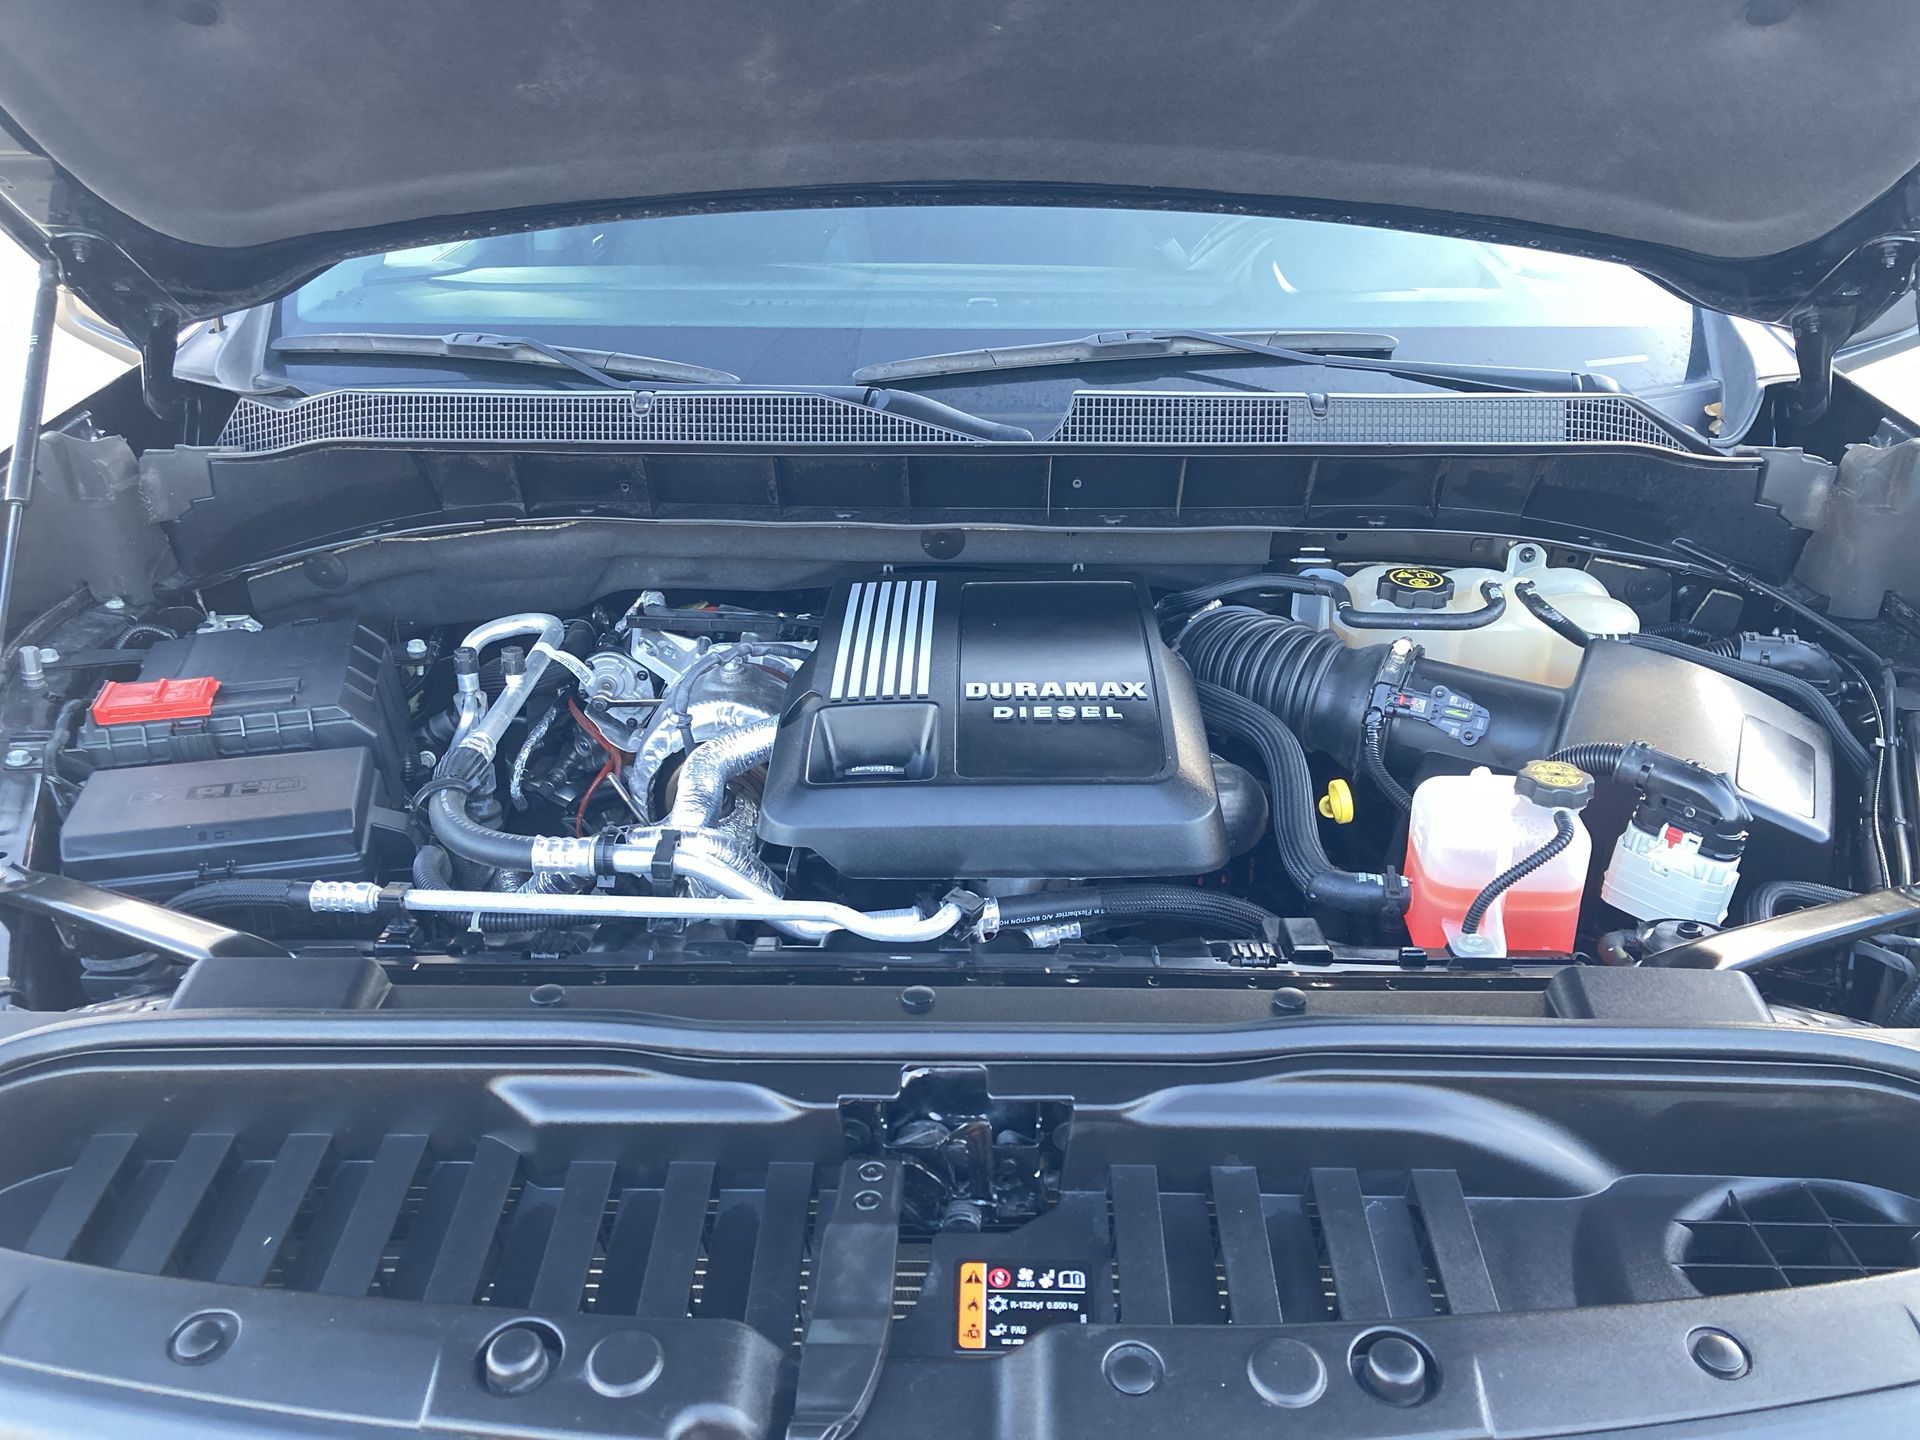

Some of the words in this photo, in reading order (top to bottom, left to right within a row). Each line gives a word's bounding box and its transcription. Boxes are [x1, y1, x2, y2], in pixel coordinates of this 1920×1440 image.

[965, 681, 1148, 699] DURAMAX
[993, 705, 1124, 719] DIESEL
[1010, 916, 1040, 925] SUCTION
[1010, 1301, 1044, 1311] R-1234yf
[1068, 1302, 1079, 1311] kg
[1010, 1326, 1027, 1335] PAG
